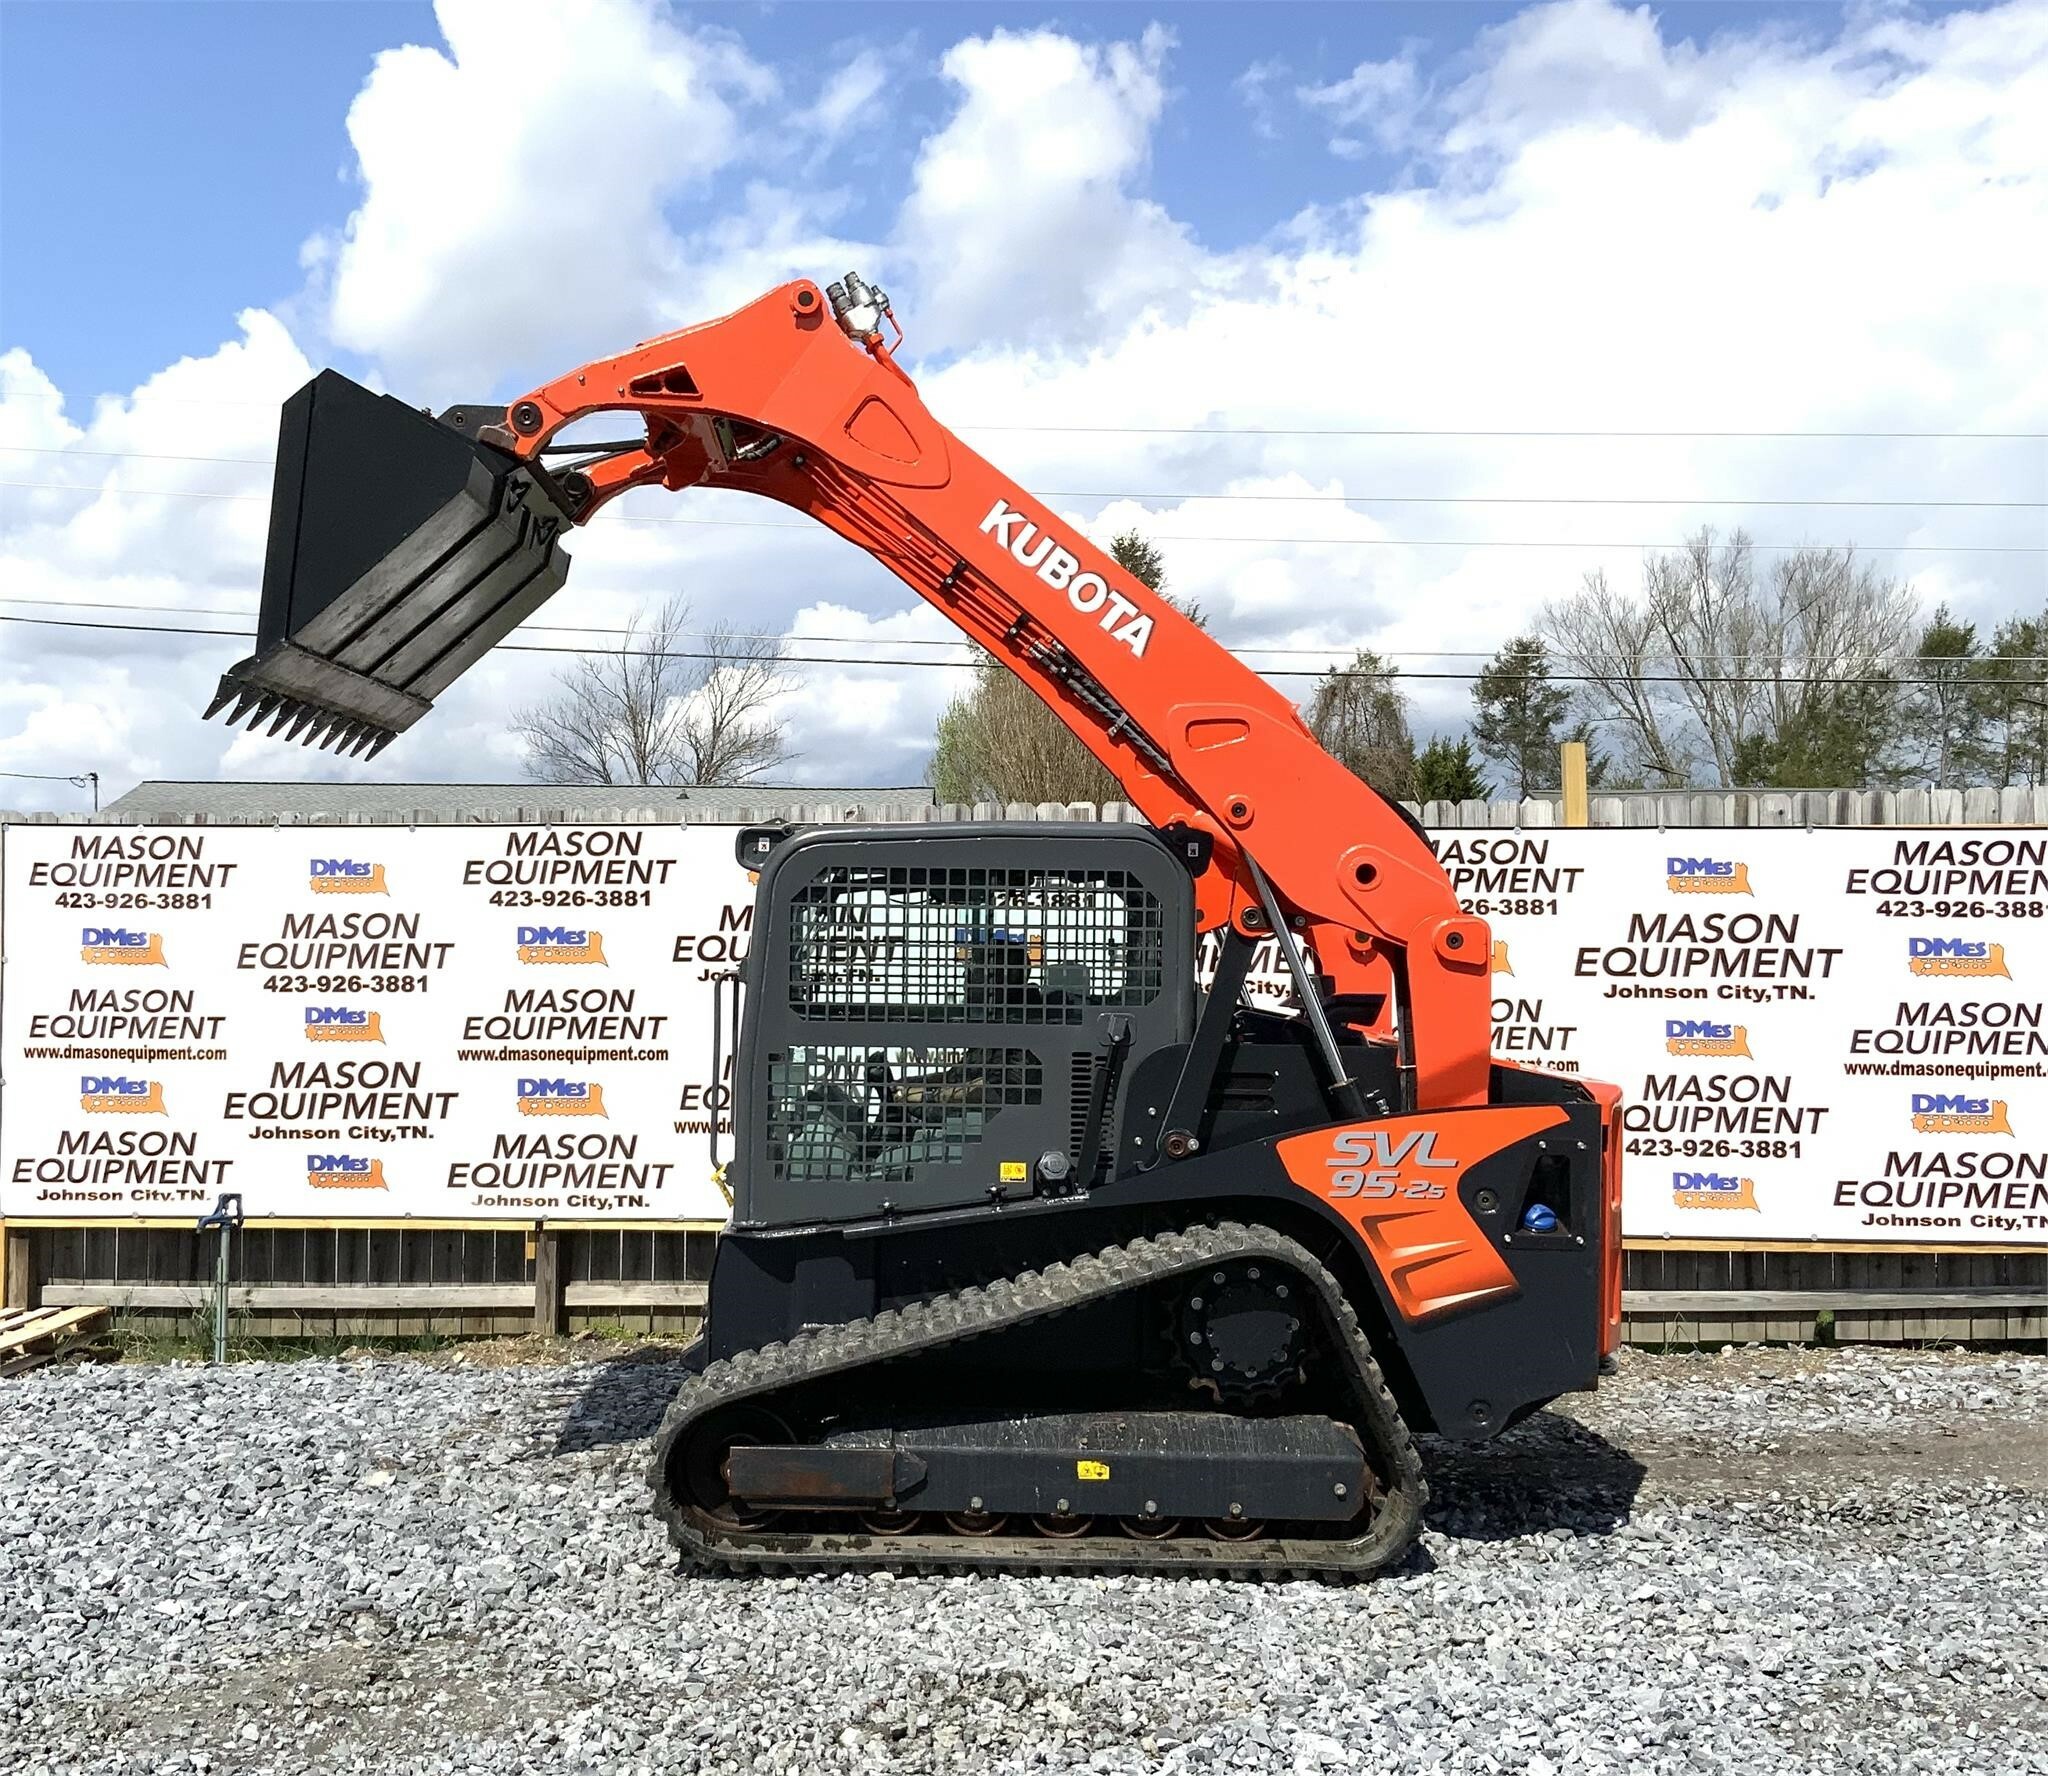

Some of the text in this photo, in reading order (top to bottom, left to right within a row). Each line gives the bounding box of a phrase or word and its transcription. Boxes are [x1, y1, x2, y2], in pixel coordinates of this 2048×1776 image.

[978, 498, 1154, 659] KUBOTA
[70, 835, 204, 861] MASON
[505, 830, 643, 857] MASON
[1893, 840, 2048, 867] MASON
[28, 862, 238, 888] EQUIPMENT
[462, 859, 677, 885] EQUIPMENT
[1449, 867, 1584, 894] PMENT
[1845, 868, 2048, 896] EQUIPMEN
[54, 892, 211, 910] 423-926-3881
[489, 889, 651, 907] 423-926-3881
[1459, 898, 1558, 916] 26-3881
[1876, 900, 2048, 919] 423-926-388
[281, 912, 421, 940] MASON
[1627, 912, 1800, 945] MASON
[236, 942, 455, 970] EQUIPMENT
[1574, 946, 1844, 979] EQUIPMENT
[263, 974, 428, 993] 423-926-3881
[1603, 984, 1816, 1004] Johnson City,TN.
[68, 988, 195, 1014] MASON
[503, 988, 636, 1014] MASON
[29, 1014, 227, 1040] EQUIPMENT
[462, 1015, 668, 1041] EQUIPMENT
[1895, 1002, 2043, 1028] MASON
[23, 1044, 227, 1064] www.dmasonequipment.com
[457, 1045, 669, 1065] www.dmasonequipment.com
[1849, 1029, 2048, 1056] EQUIPMEN
[269, 1060, 421, 1090] MASON
[1843, 1059, 2047, 1081] www.dmasonequipment.
[1642, 1074, 1792, 1103] MASON
[223, 1092, 460, 1120] EQUIPMENT
[1623, 1104, 1830, 1135] QUIPMENT
[56, 1130, 198, 1157] MASON
[248, 1125, 434, 1143] Johnson City,TN.
[492, 1133, 638, 1160] MASON
[1325, 1131, 1459, 1168] SVL
[1625, 1138, 1801, 1159] 423-926-3881
[11, 1158, 234, 1185] EQUIPMENT
[447, 1162, 675, 1189] EQUIPMENT
[1883, 1151, 2048, 1180] MASON
[36, 1188, 123, 1201] Johnson
[1328, 1169, 1447, 1200] 95-25
[1833, 1180, 2048, 1210] EQUIPMEN
[471, 1194, 650, 1211] Johnson City,TN.
[1861, 1213, 2048, 1231] Johnson City,T
